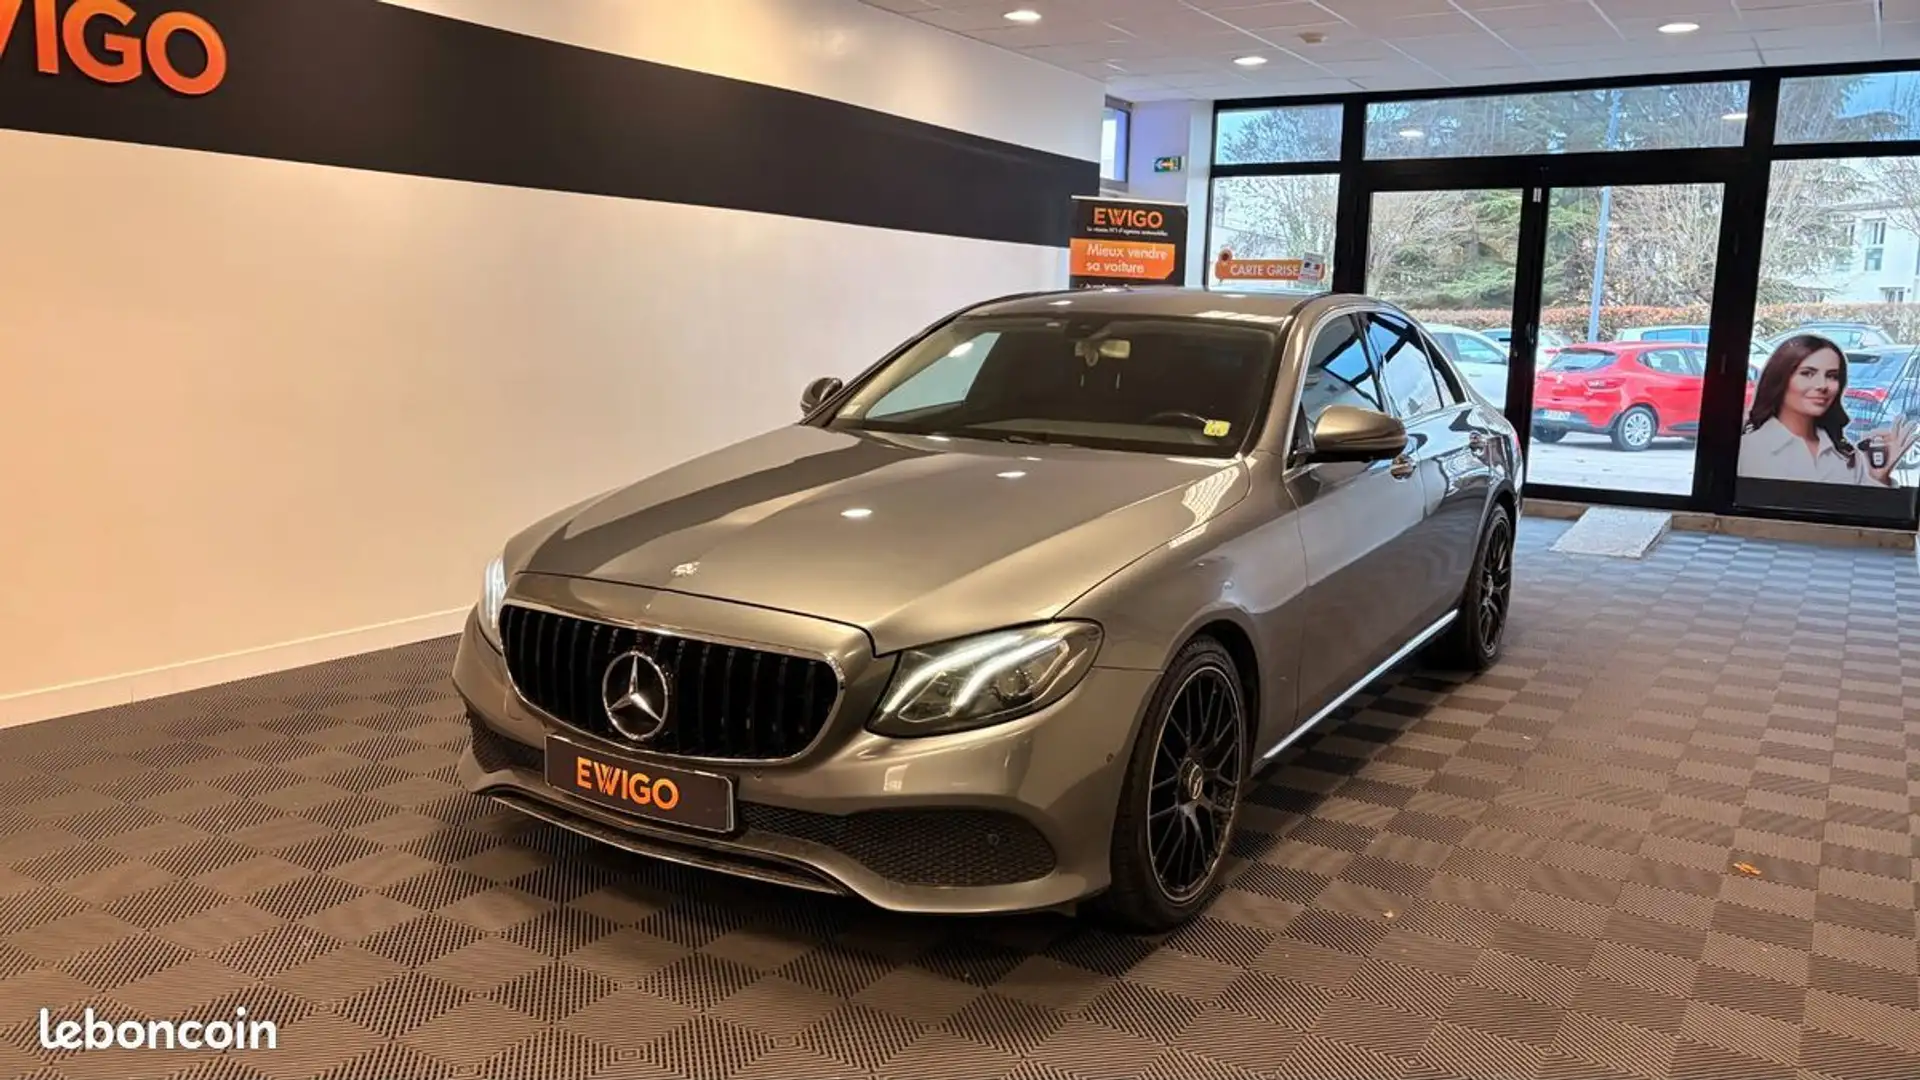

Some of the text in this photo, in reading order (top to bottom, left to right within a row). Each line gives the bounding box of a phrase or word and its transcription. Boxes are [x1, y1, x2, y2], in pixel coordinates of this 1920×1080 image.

[1093, 207, 1163, 229] EWIGO
[1087, 243, 1169, 260] Mieux vendre
[1086, 260, 1145, 274] sa voiture
[1230, 263, 1265, 277] CARTE
[1266, 264, 1299, 277] GRISE
[576, 756, 679, 811] EWIGO
